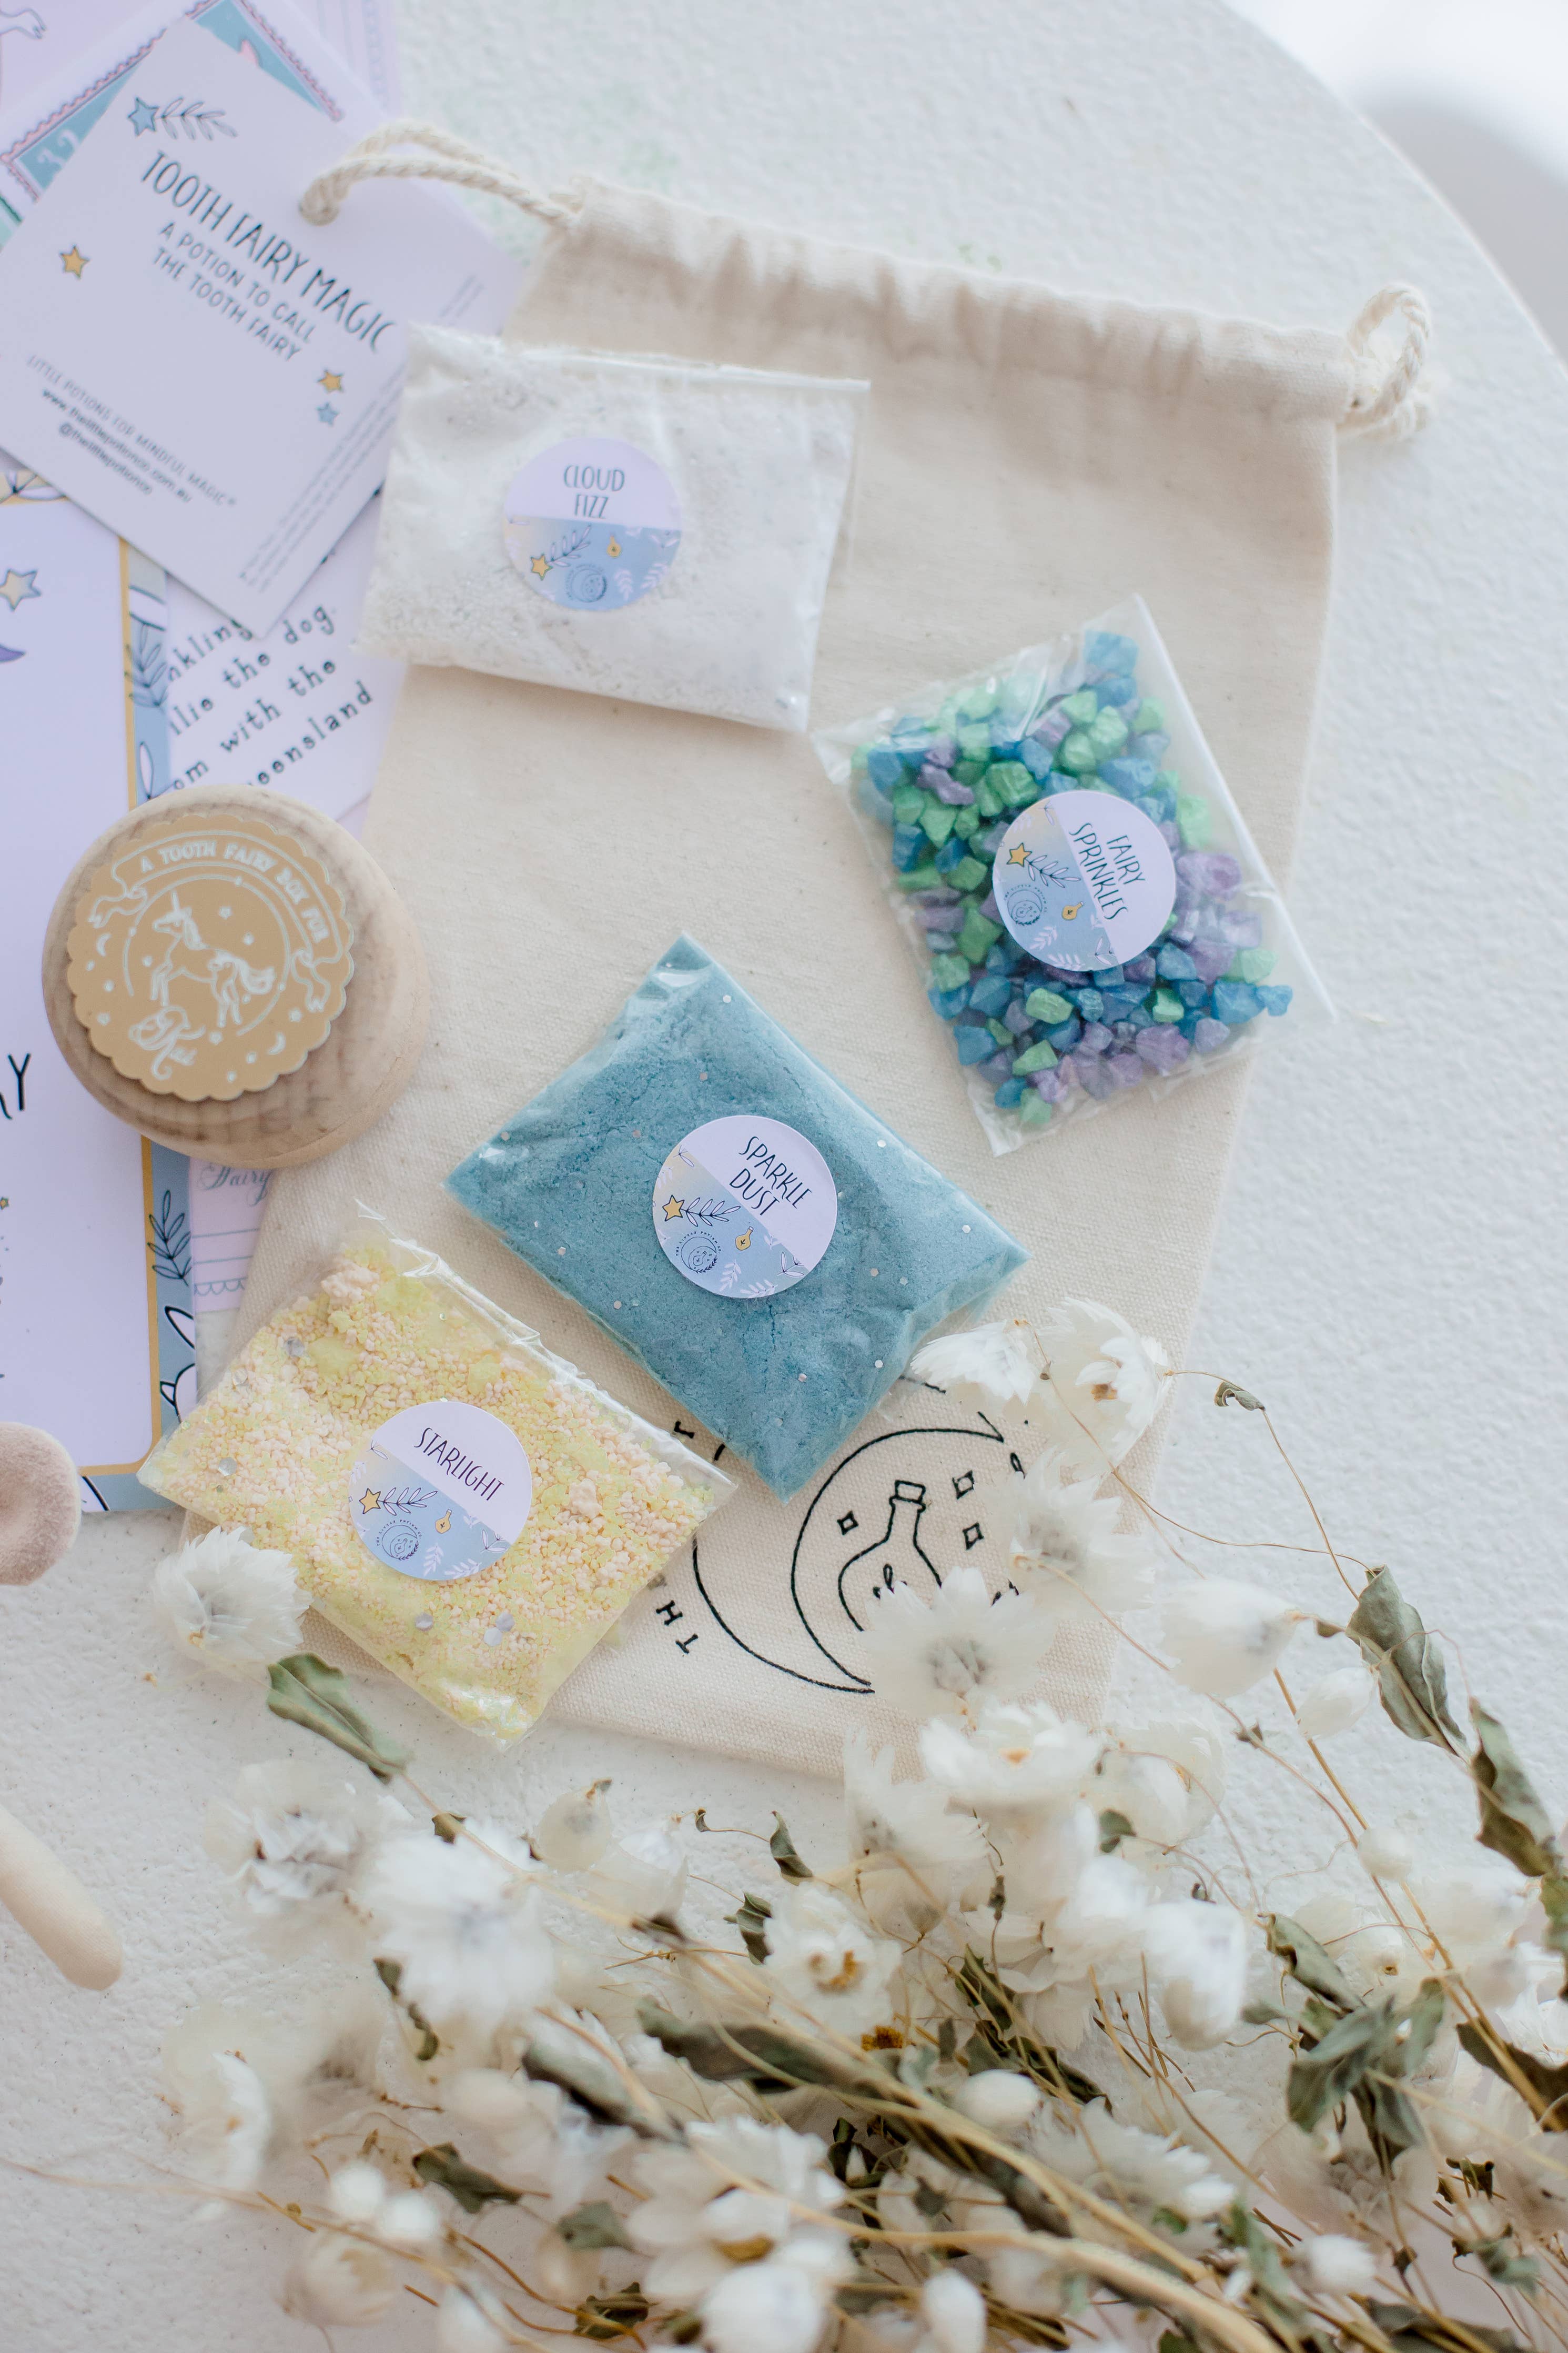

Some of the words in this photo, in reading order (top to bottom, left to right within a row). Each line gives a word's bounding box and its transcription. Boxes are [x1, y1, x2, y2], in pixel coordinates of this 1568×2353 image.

[141, 150, 233, 232] TOOTH
[225, 213, 310, 284] FAIRY
[300, 268, 396, 354] MAGIC
[160, 222, 175, 240] A
[178, 233, 245, 287] POTION
[247, 281, 270, 307] TO
[273, 303, 316, 343] CALL
[153, 247, 187, 280] THE
[190, 273, 247, 324] TOOTH
[248, 317, 301, 360] FAIRY
[64, 379, 112, 420] POTIONS
[136, 434, 186, 475] MINDFUL
[564, 465, 625, 491] CLOUD
[574, 494, 608, 519] FIZZ
[219, 699, 281, 752] with
[288, 660, 336, 696] the
[223, 652, 270, 689] the
[248, 680, 372, 785] eensland
[142, 856, 154, 873] A
[159, 840, 217, 864] TOOTH
[224, 842, 277, 872] FAIRY
[276, 867, 309, 904] BOX
[301, 906, 329, 942] FOR
[1068, 823, 1128, 920] SPRINKLES
[1106, 835, 1146, 884] FAIRY
[729, 1168, 780, 1216] DUST
[738, 1136, 813, 1209] SPARKLE
[679, 1231, 696, 1244] LITTLE
[413, 1427, 505, 1502] STARLIGHT
[379, 1520, 396, 1534] LITTLE
[652, 1585, 699, 1654] TH
